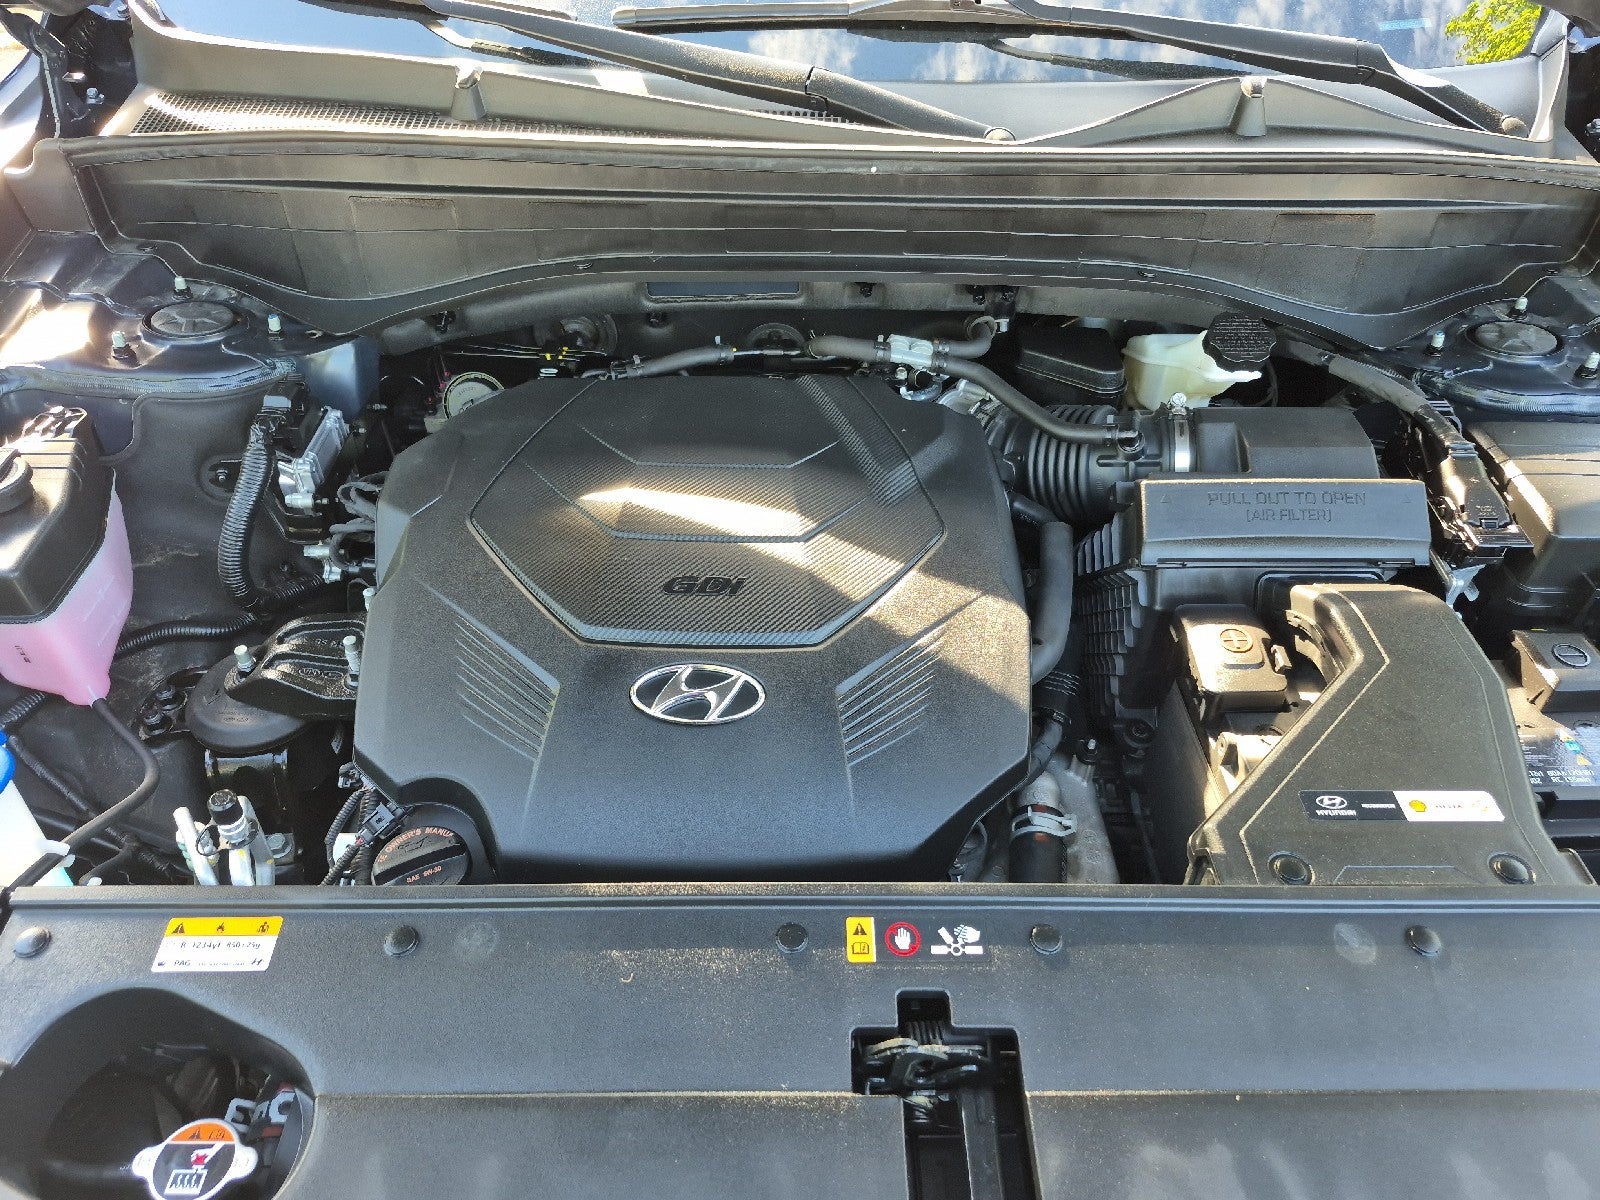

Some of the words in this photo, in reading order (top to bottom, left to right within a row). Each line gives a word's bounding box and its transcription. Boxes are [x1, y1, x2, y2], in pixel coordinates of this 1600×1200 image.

[1208, 492, 1251, 506] PULL
[1255, 491, 1289, 505] OUT
[1295, 491, 1317, 505] TO
[1321, 491, 1366, 505] OPEN
[385, 828, 422, 853] OWNER'S
